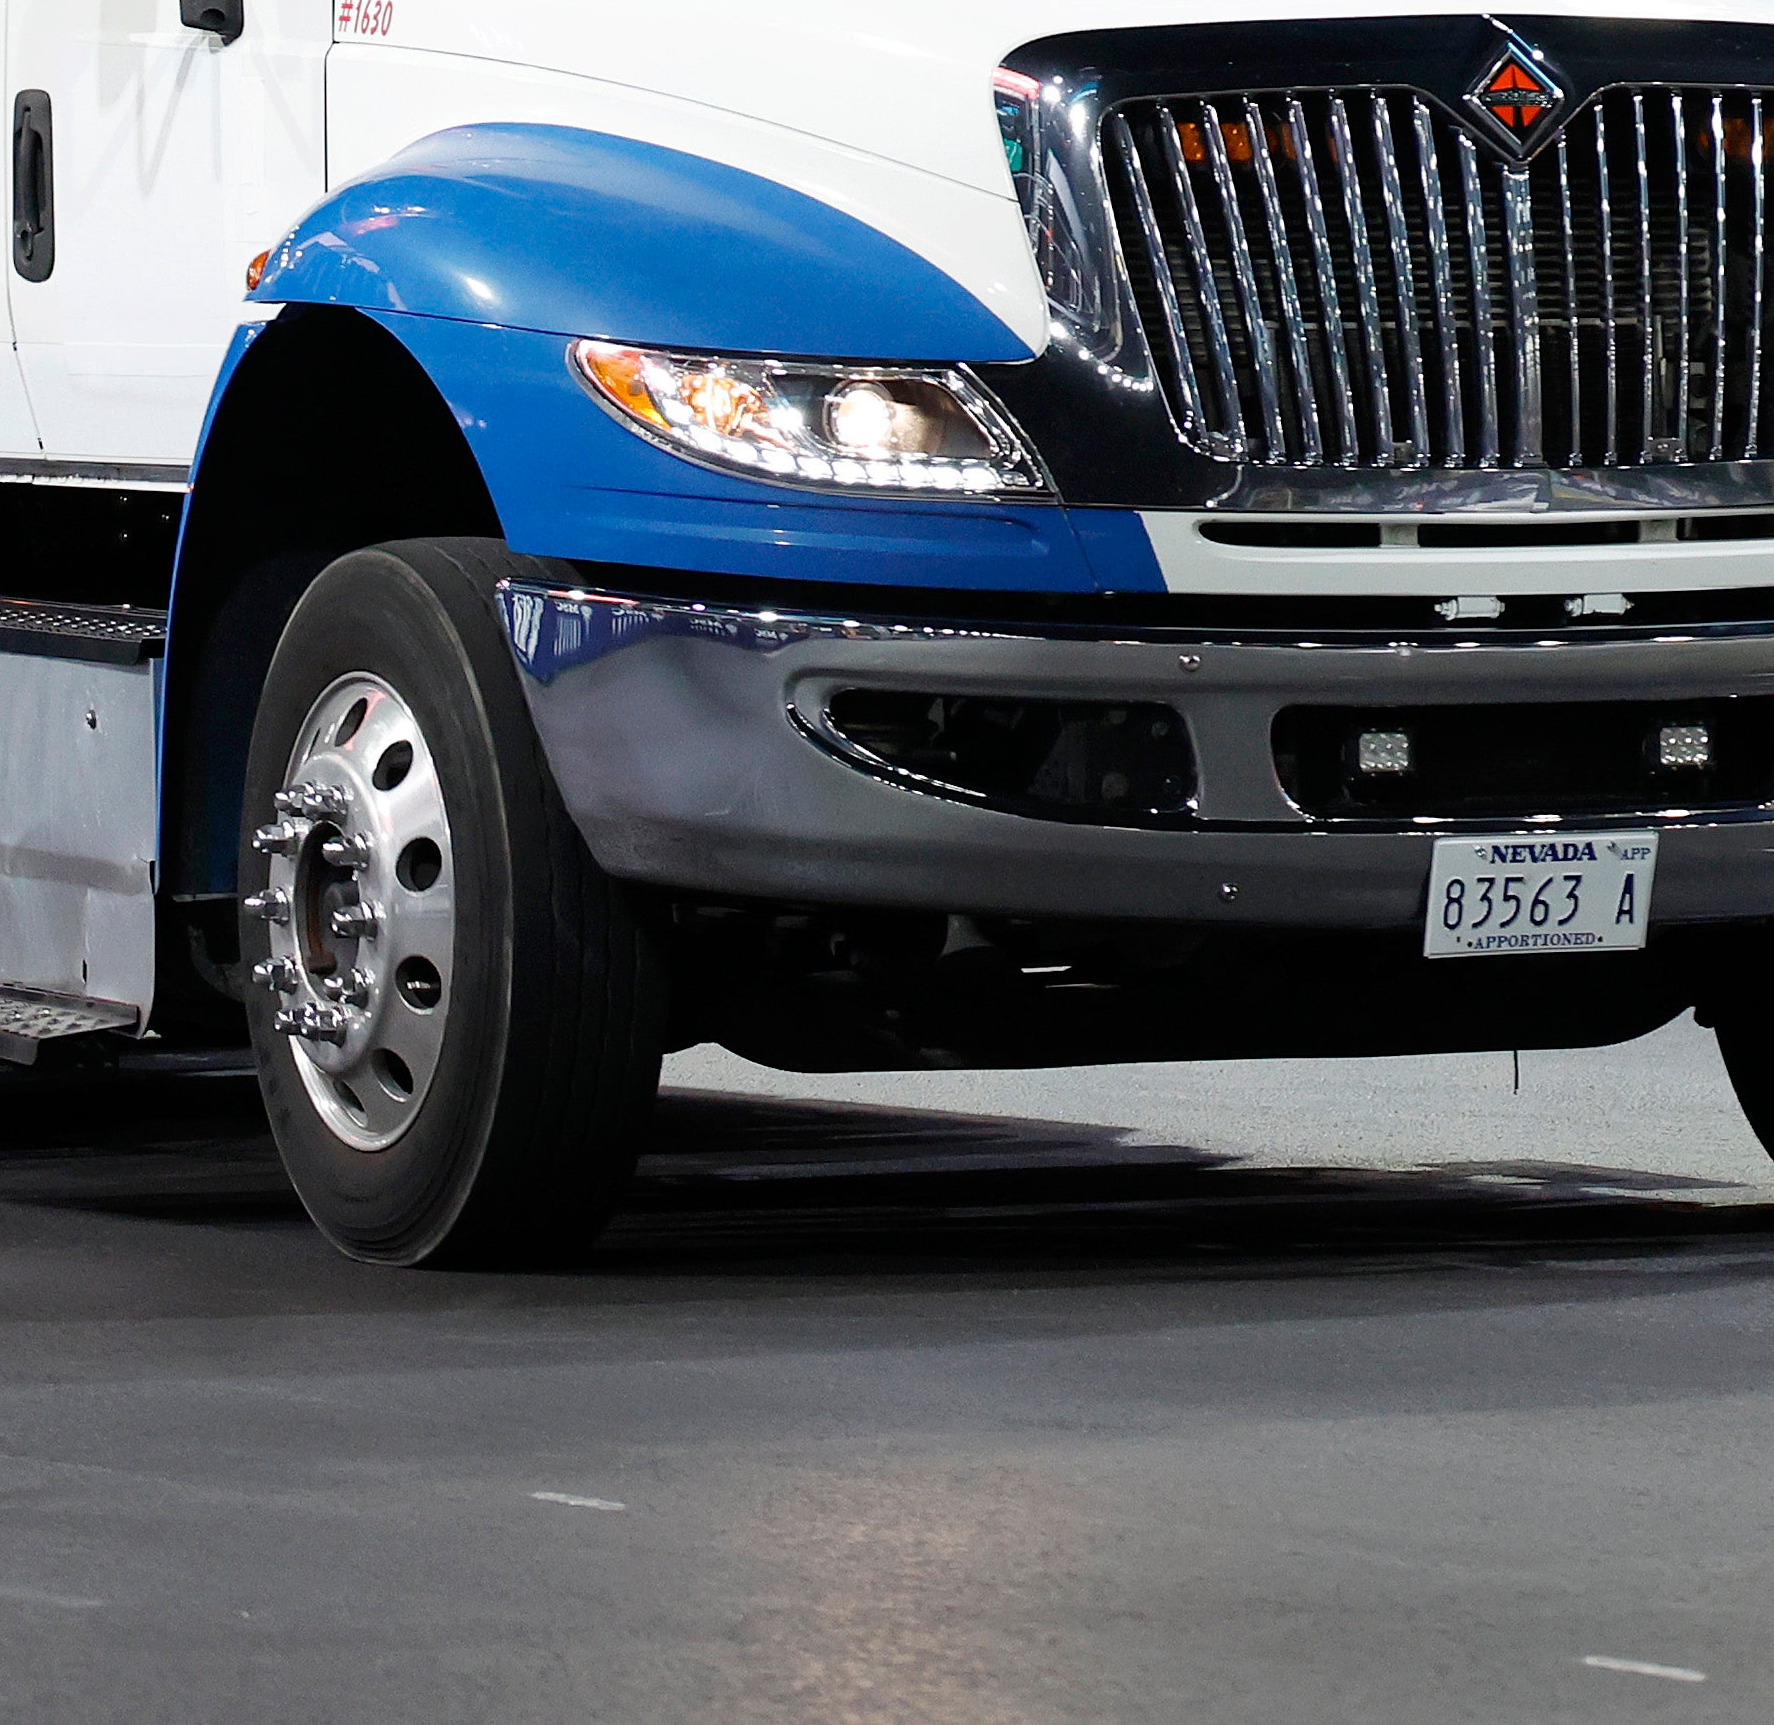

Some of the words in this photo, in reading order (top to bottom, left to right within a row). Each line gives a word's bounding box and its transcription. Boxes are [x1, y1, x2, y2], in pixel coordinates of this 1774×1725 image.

[1489, 841, 1598, 865] NEVADA
[1620, 847, 1652, 861] APP
[1443, 875, 1583, 931] 83563
[1615, 873, 1635, 925] A
[1473, 932, 1596, 950] APPORTIONED
